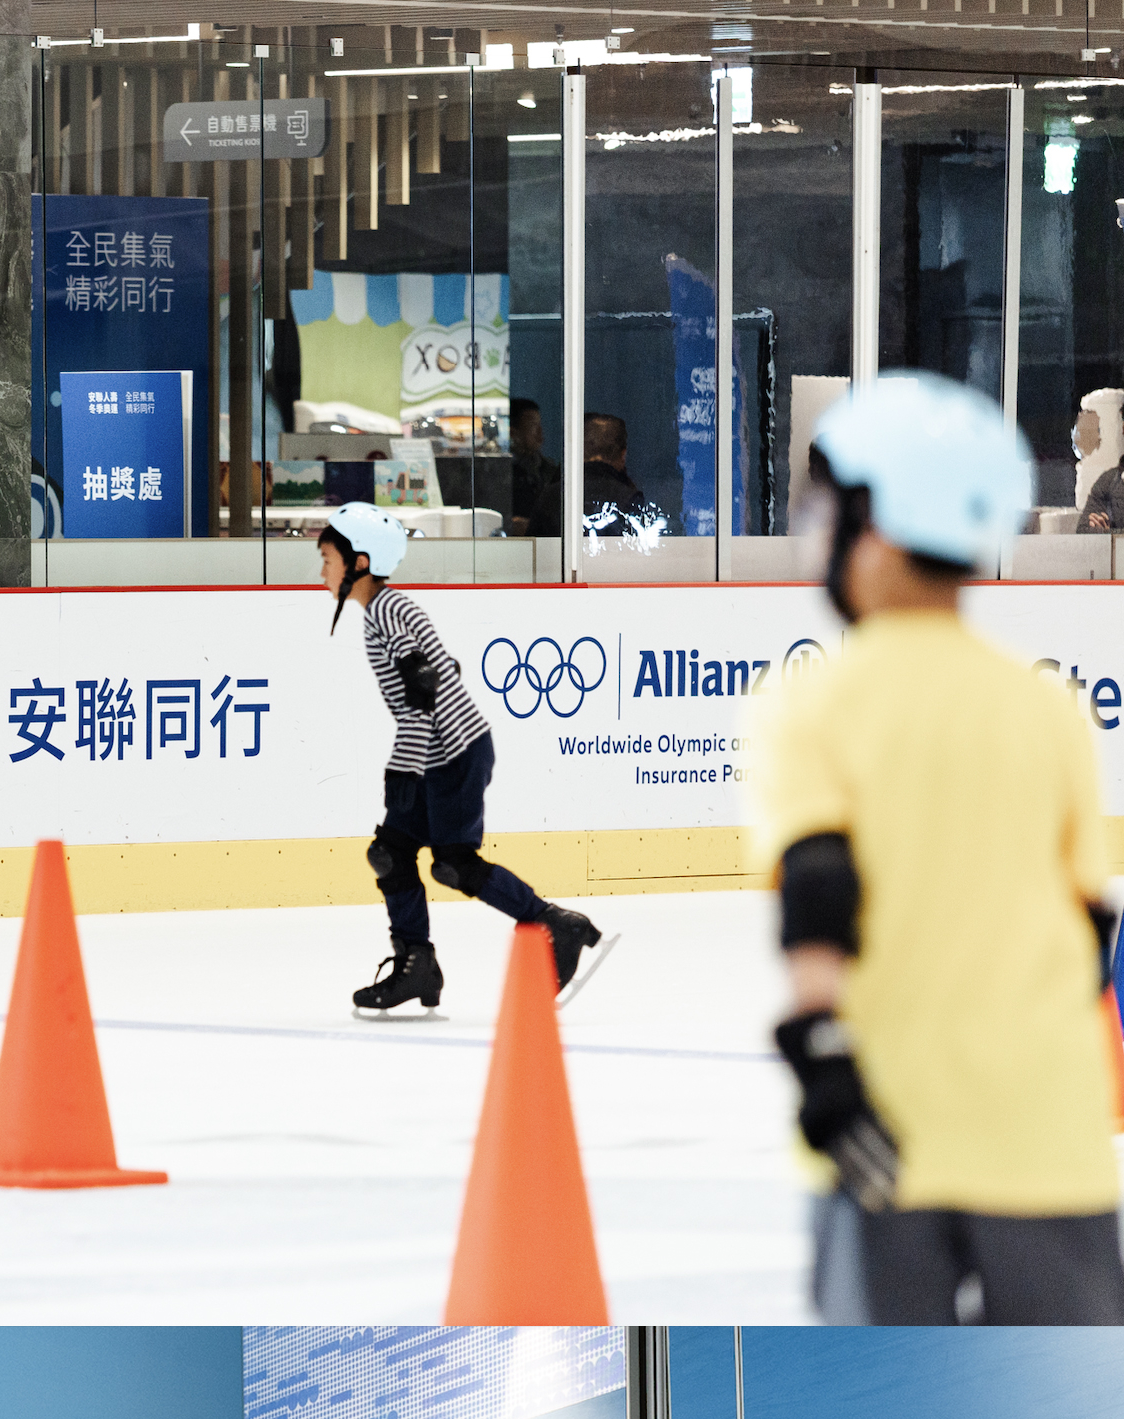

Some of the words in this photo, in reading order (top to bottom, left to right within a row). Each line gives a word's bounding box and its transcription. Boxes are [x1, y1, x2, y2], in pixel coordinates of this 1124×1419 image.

[207, 113, 277, 134] 自動售票機
[244, 138, 262, 147] KIOS
[65, 231, 175, 269] 全民集氣
[65, 274, 175, 313] 精彩同行
[82, 466, 163, 501] 抽獎處
[632, 649, 771, 698] Allianz
[8, 674, 271, 763] 安聯同行
[559, 734, 652, 755] Worldwide
[657, 733, 726, 757] Olympic
[731, 737, 753, 752] an
[635, 766, 717, 785] Insurance
